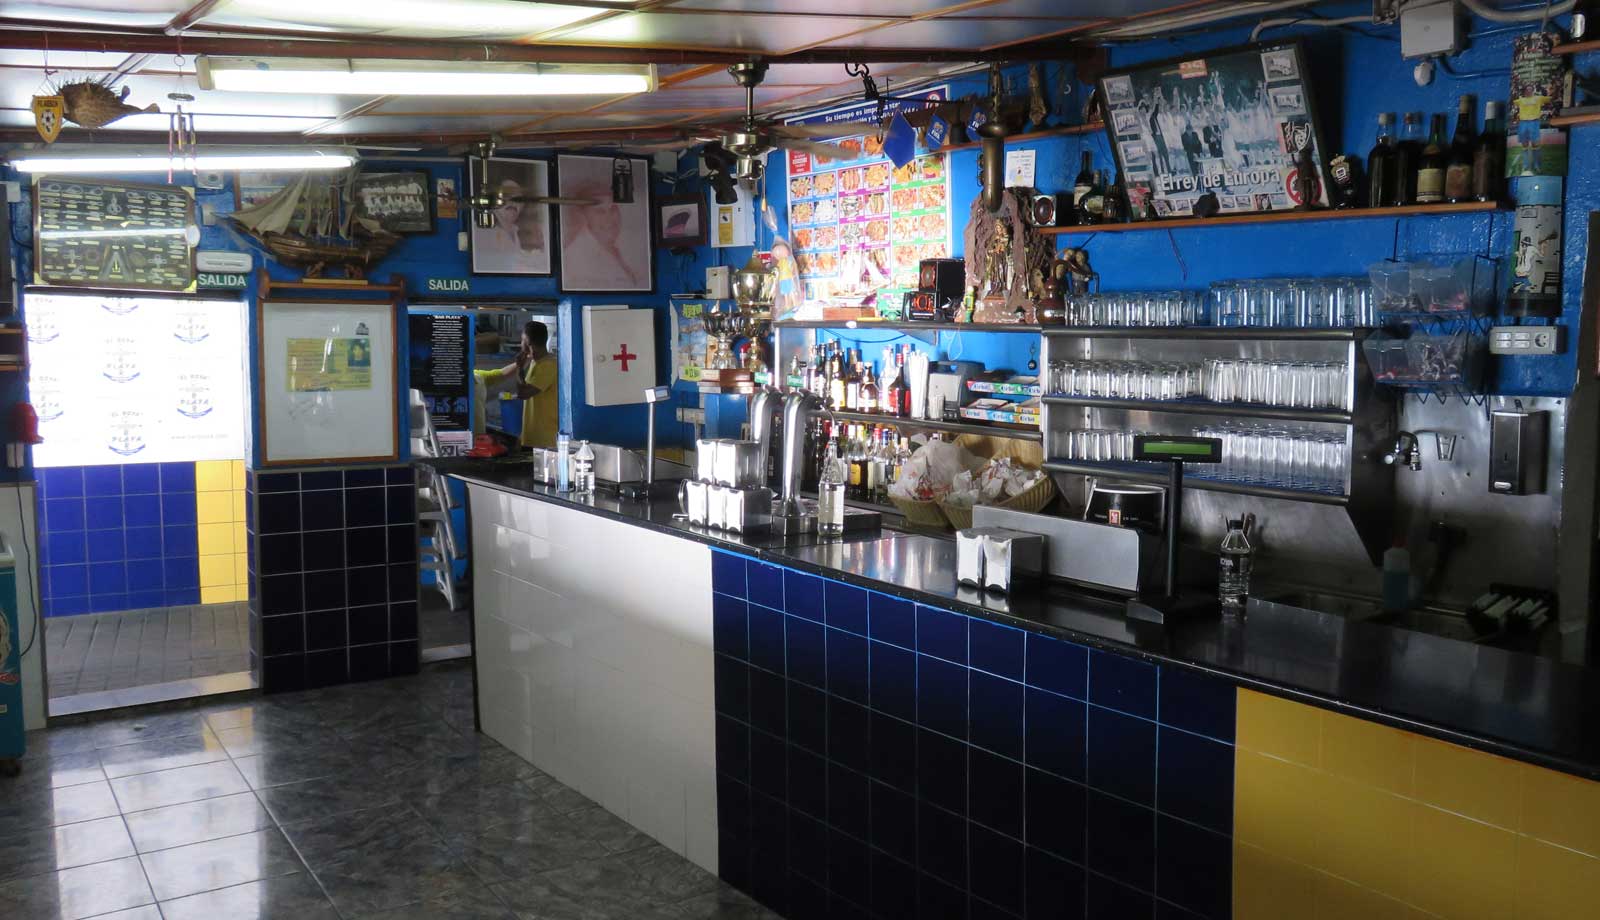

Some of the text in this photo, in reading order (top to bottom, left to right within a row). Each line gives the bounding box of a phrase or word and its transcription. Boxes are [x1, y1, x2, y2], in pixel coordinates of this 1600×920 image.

[825, 115, 832, 123] Su
[834, 111, 855, 120] tiempo
[1160, 169, 1281, 192] El rey de Europa
[198, 273, 247, 287] SALIDA
[428, 279, 469, 291] SALIDA
